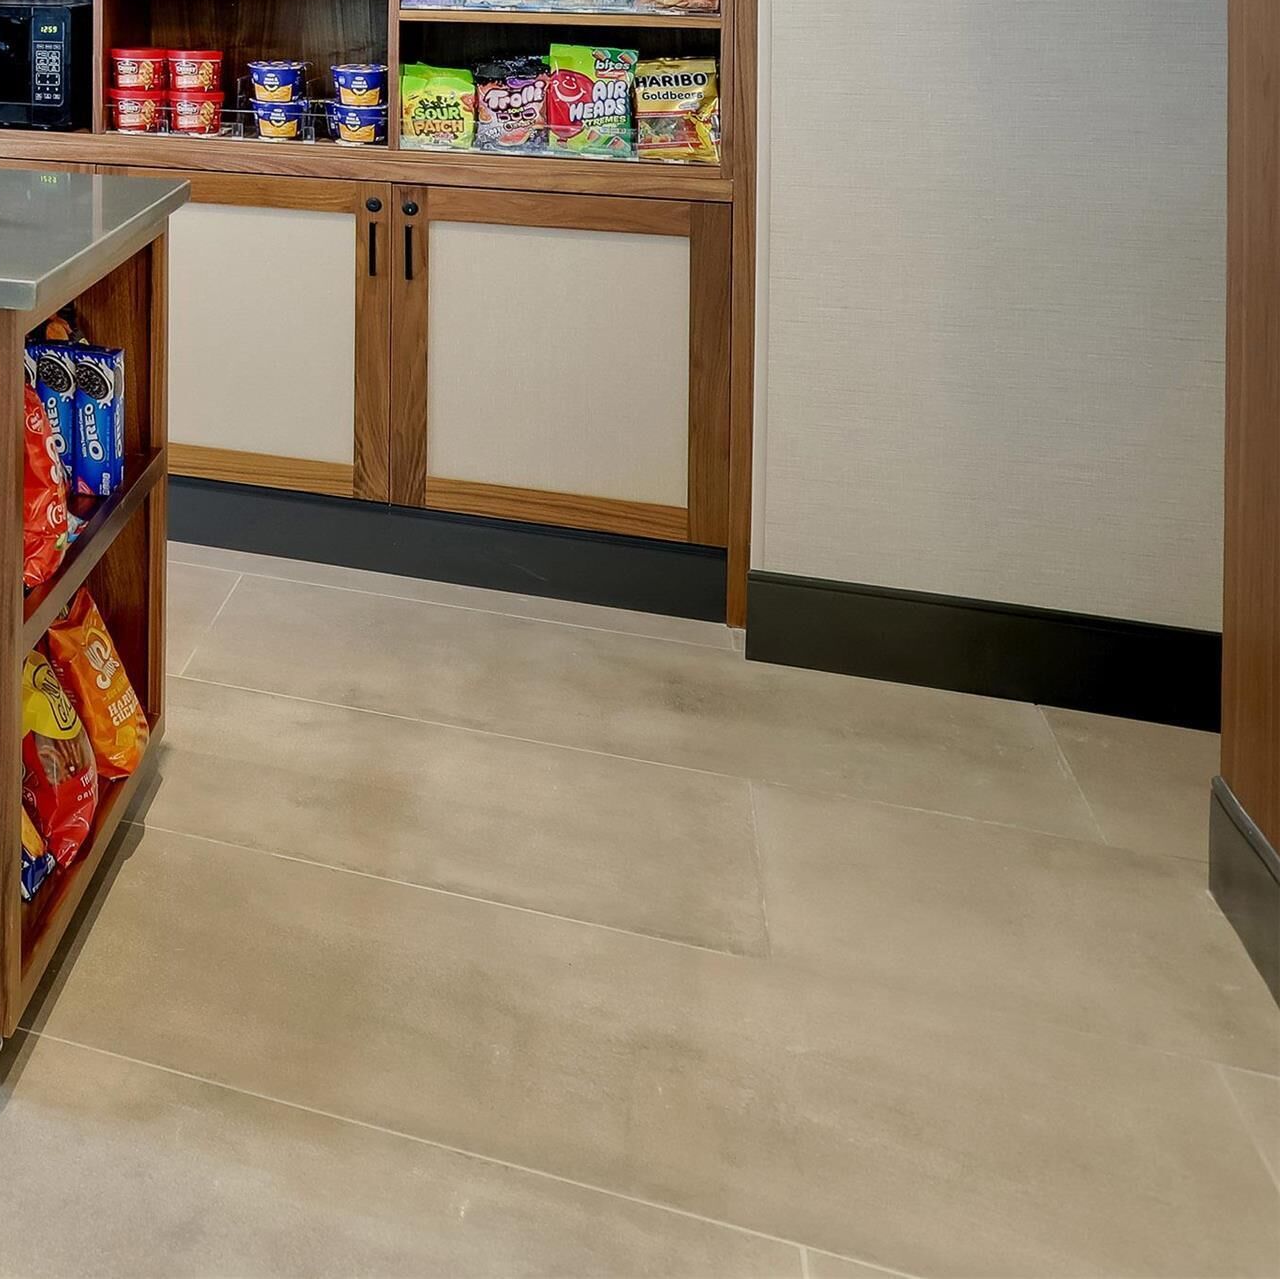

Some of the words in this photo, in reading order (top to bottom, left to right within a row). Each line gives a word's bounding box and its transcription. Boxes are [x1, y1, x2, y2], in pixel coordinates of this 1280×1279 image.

[596, 59, 630, 70] bites
[636, 74, 707, 88] HARIBO
[484, 81, 546, 111] Trolli
[593, 80, 627, 99] AIR
[642, 91, 703, 100] Goldbears
[415, 107, 460, 120] SOUR
[570, 99, 626, 121] HEADS
[414, 120, 464, 135] PATCH
[582, 115, 627, 127] XTREMES
[47, 397, 66, 454] OREO
[84, 404, 105, 460] OREO
